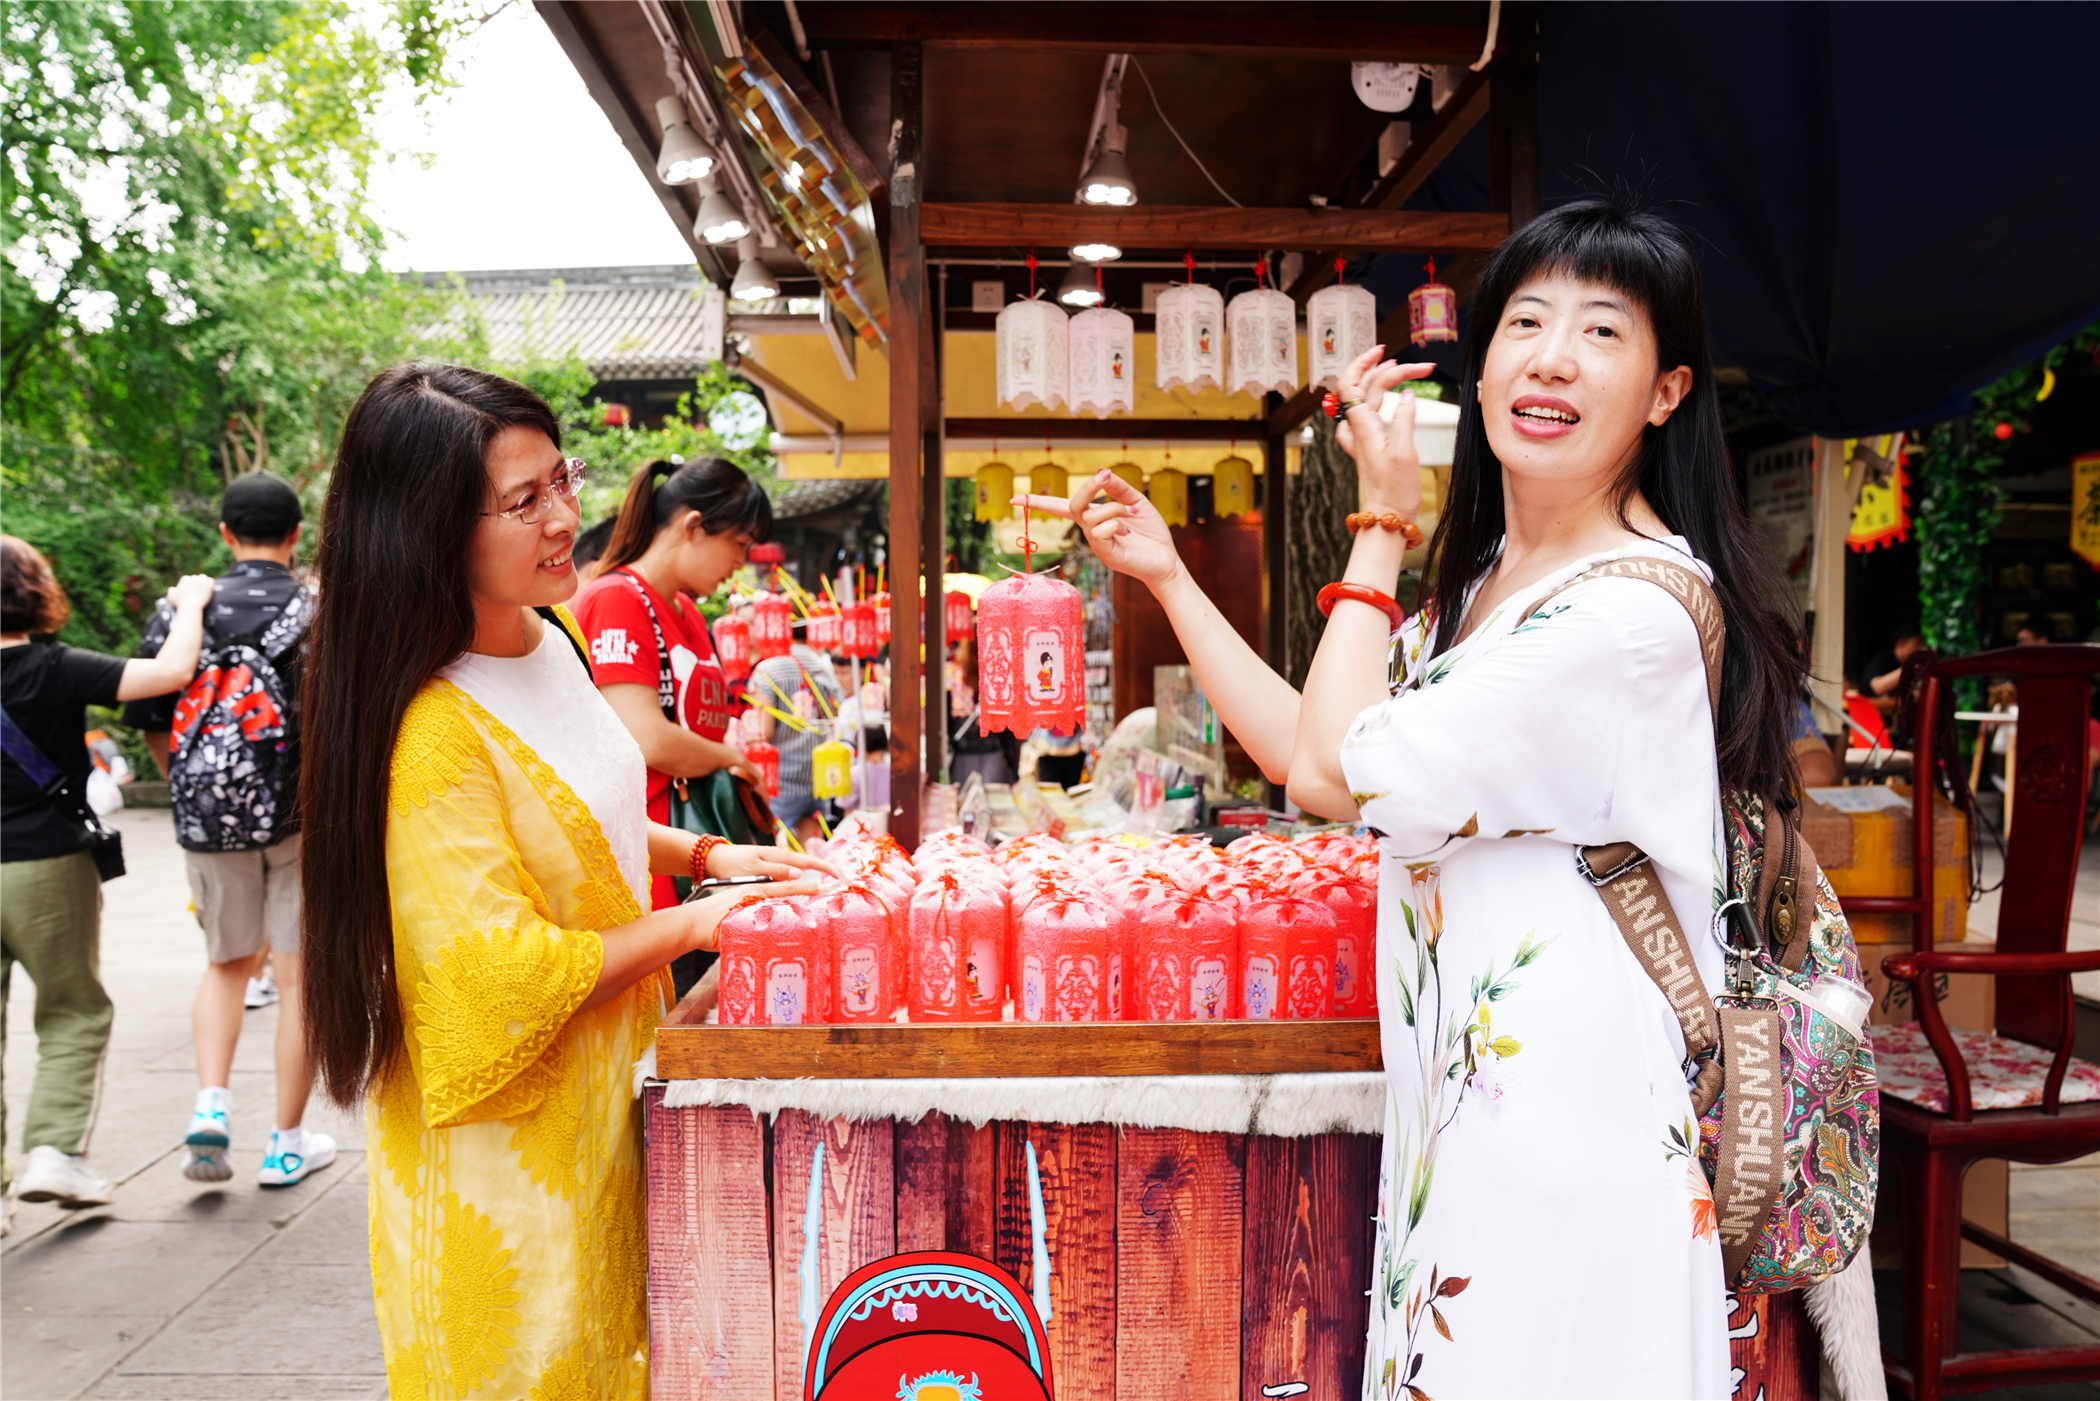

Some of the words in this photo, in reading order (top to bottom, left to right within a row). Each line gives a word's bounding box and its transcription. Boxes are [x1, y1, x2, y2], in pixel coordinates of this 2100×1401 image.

[1556, 560, 1722, 666] YANSHUA
[601, 628, 627, 641] LOVE
[591, 637, 627, 656] CHN
[595, 652, 634, 665] PANDA
[658, 668, 675, 708] SEE
